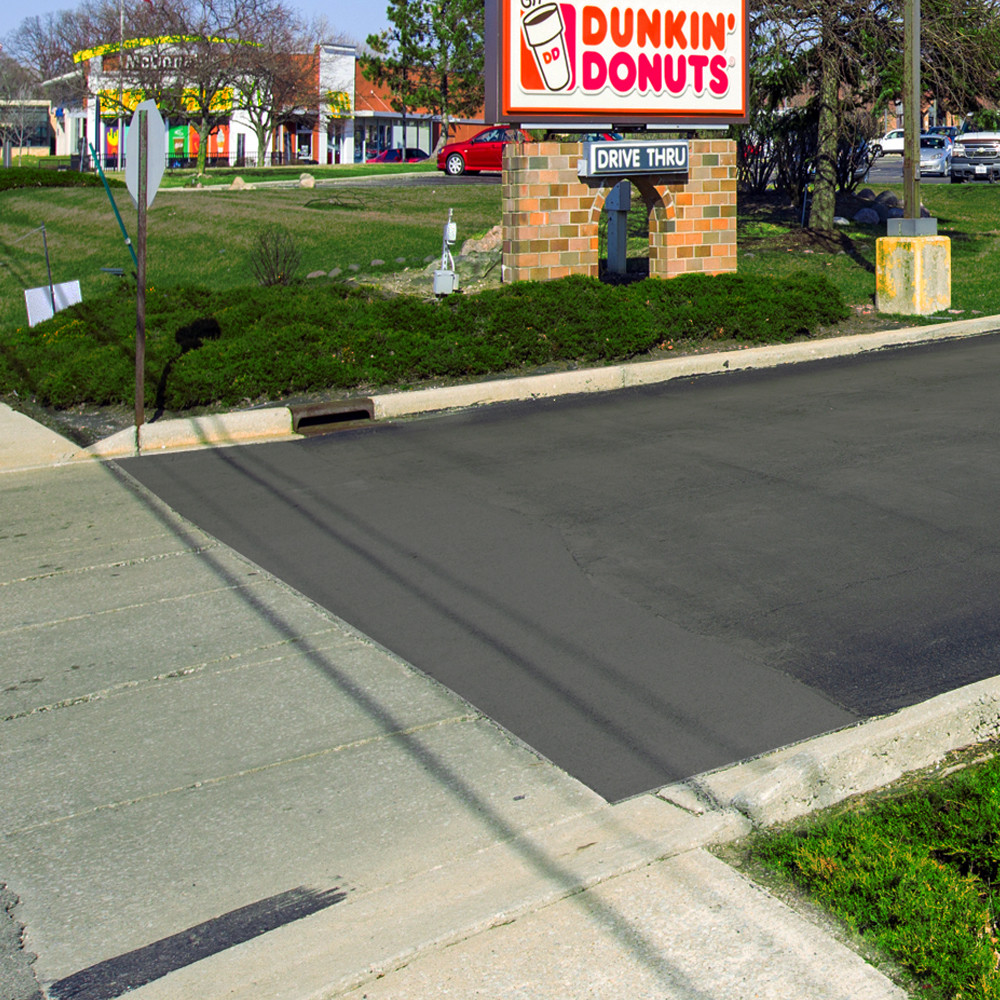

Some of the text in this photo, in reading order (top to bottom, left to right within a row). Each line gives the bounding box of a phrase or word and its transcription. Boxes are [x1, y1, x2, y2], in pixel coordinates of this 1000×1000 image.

[582, 4, 736, 51] DUNKIN'
[542, 46, 561, 65] DD
[582, 50, 729, 94] DONUTS
[597, 146, 686, 169] DRIVE THRU
